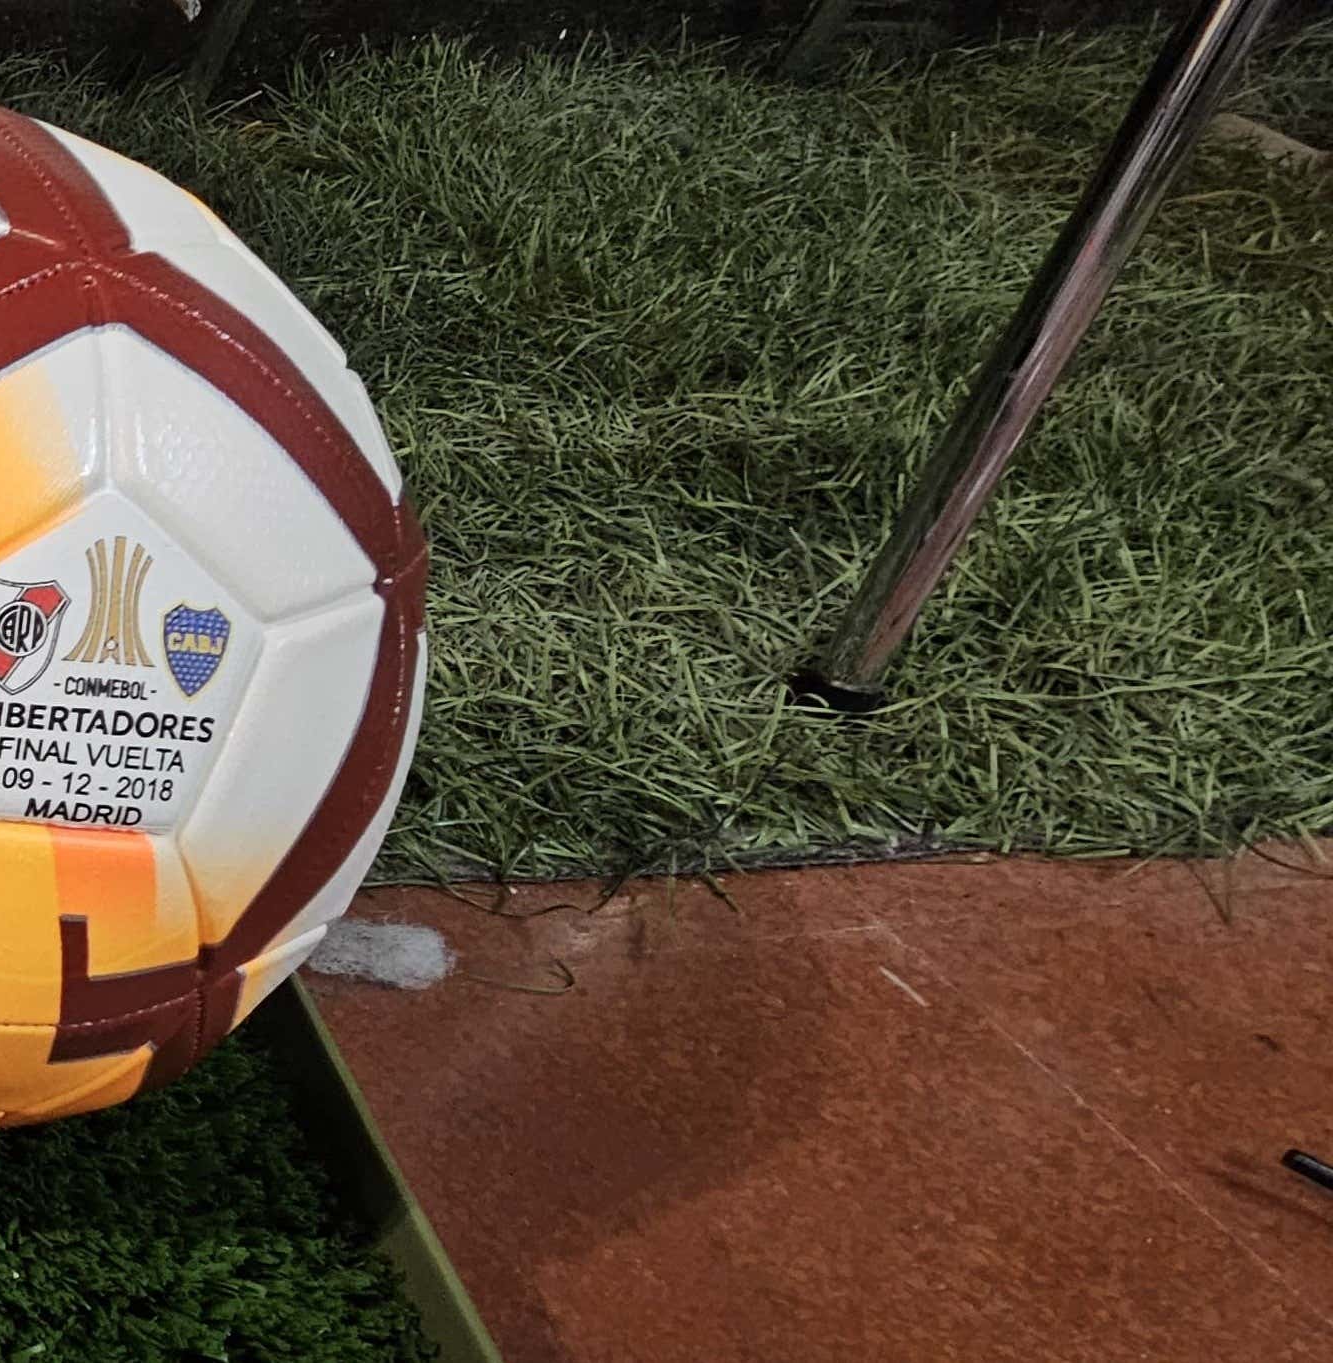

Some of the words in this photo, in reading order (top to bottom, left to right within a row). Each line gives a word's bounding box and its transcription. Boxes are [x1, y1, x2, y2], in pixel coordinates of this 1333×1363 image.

[87, 743, 185, 773] VUELTA
[2, 767, 34, 790] 09
[63, 772, 91, 796] 12
[116, 776, 174, 801] 2018
[24, 798, 142, 827] MADRID
